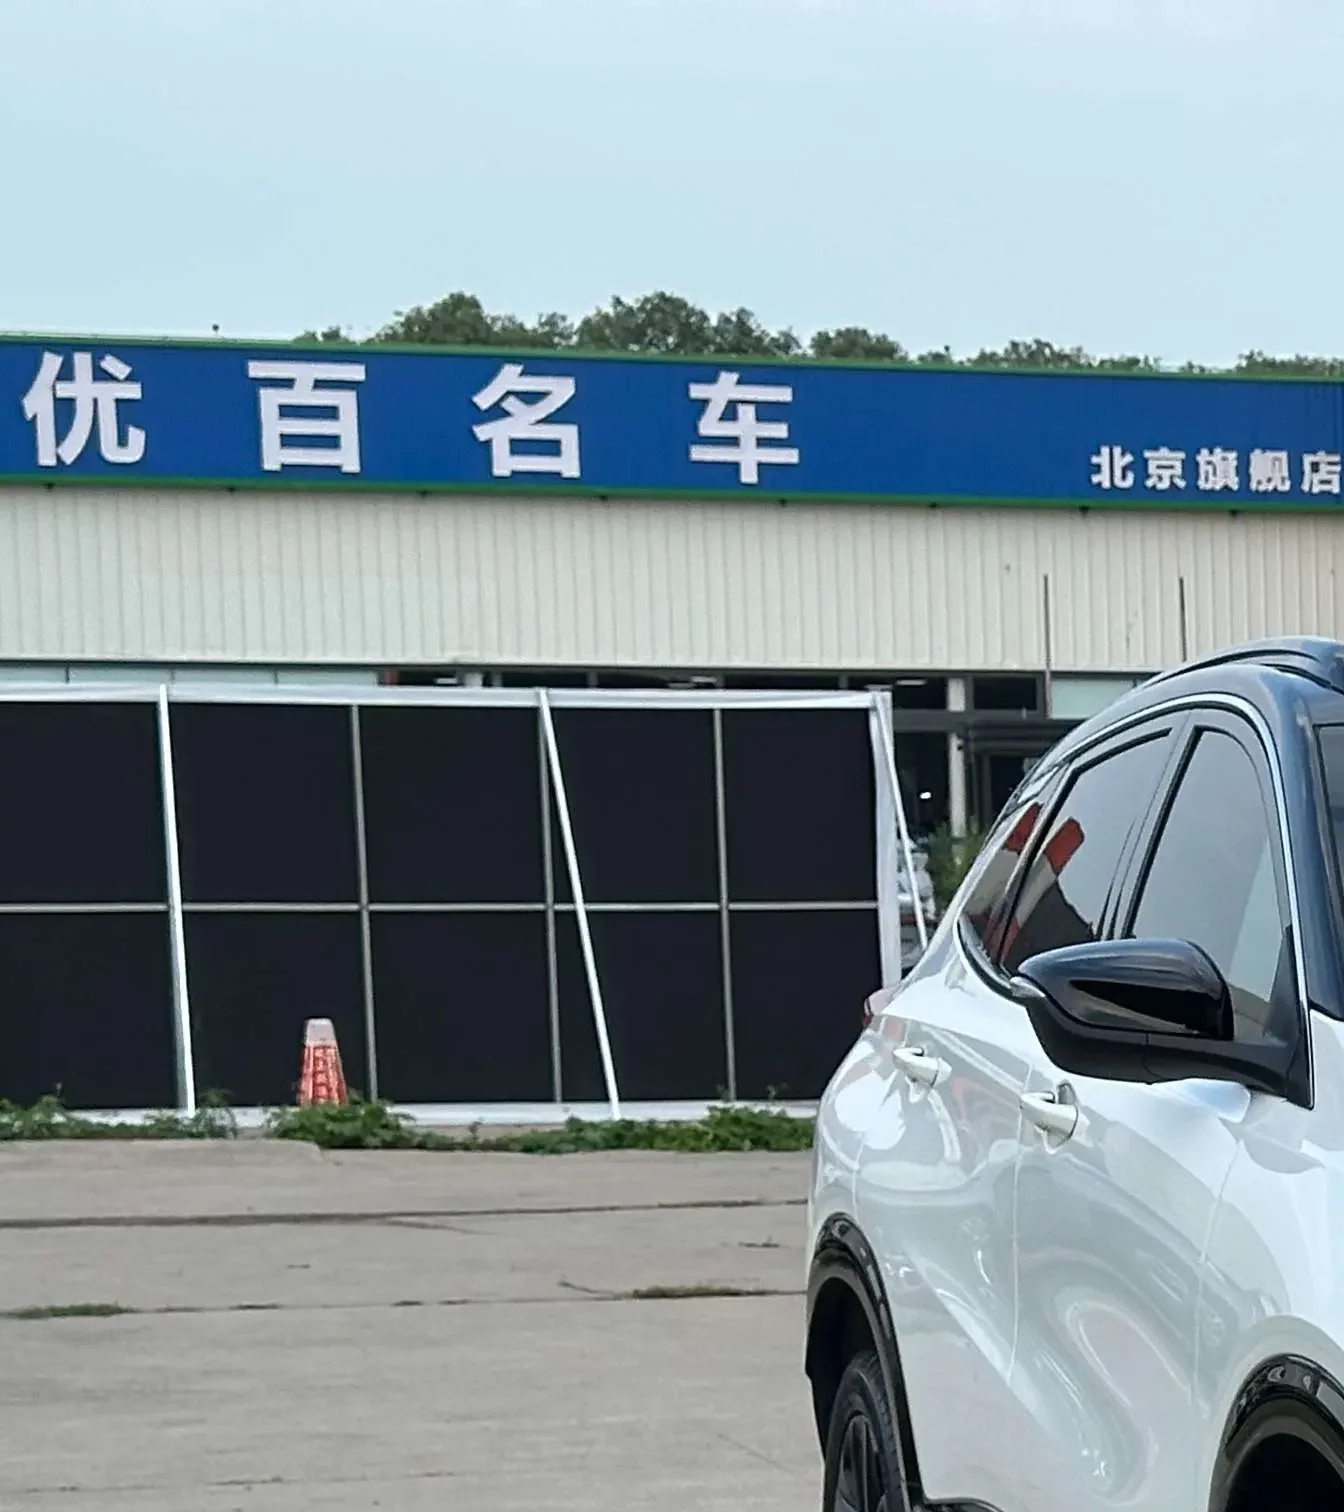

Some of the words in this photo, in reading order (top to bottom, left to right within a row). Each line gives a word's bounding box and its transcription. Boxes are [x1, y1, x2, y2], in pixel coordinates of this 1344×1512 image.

[21, 350, 801, 485] 优百名车
[1090, 445, 1344, 496] 北京旗舰店
